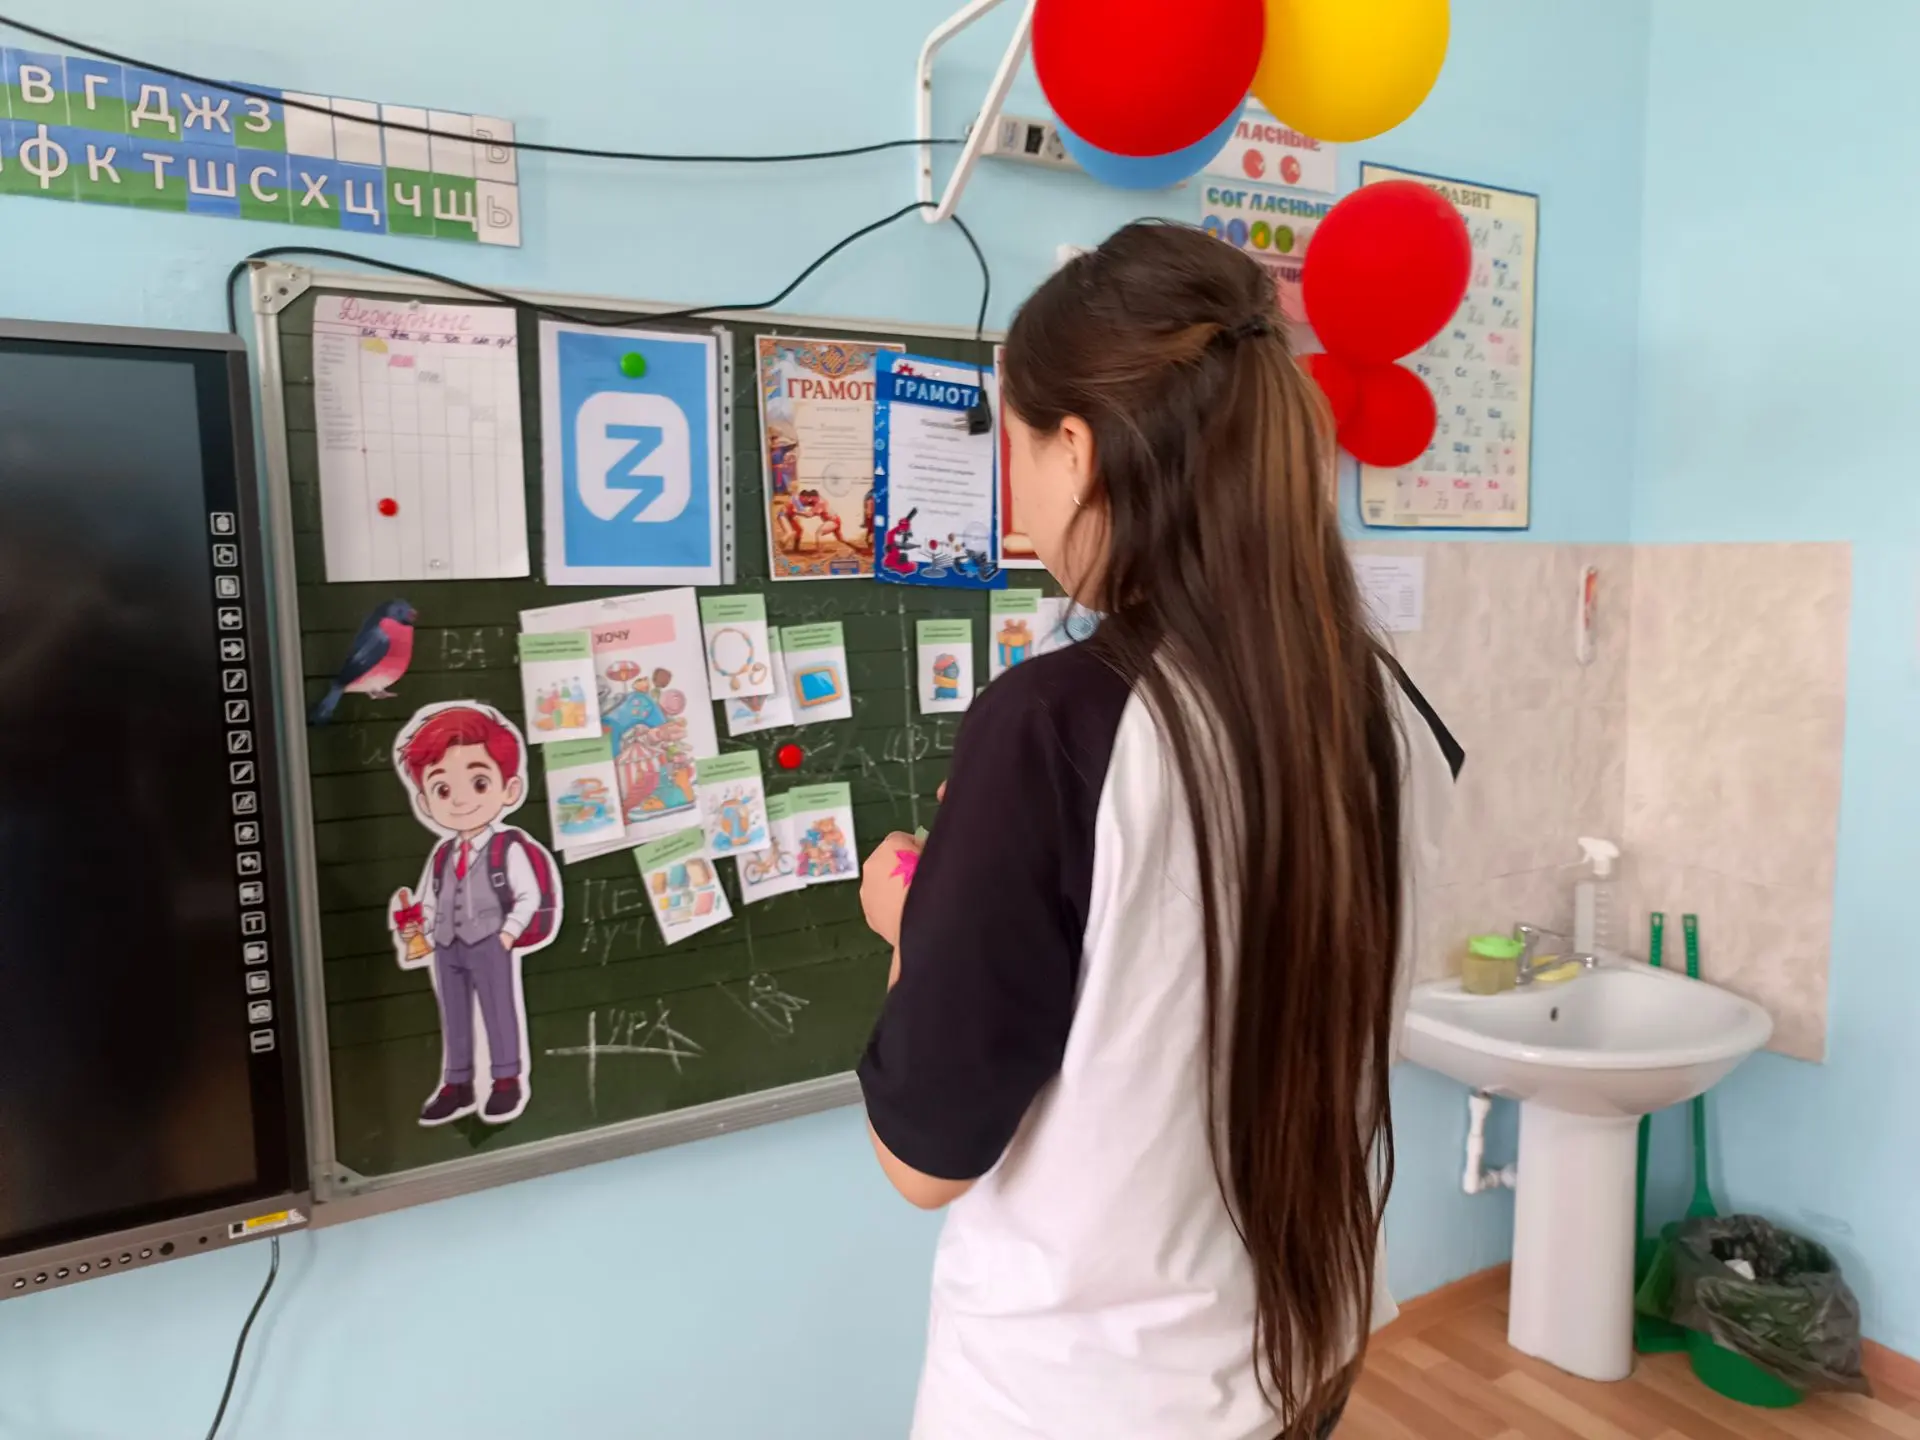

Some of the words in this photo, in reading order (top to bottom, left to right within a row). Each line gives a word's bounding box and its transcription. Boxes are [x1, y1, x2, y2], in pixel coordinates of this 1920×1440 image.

[1236, 121, 1321, 151] ЛАСНЫЕ
[787, 378, 876, 401] ГРАМОТ
[596, 630, 630, 645] ХОЧУ
